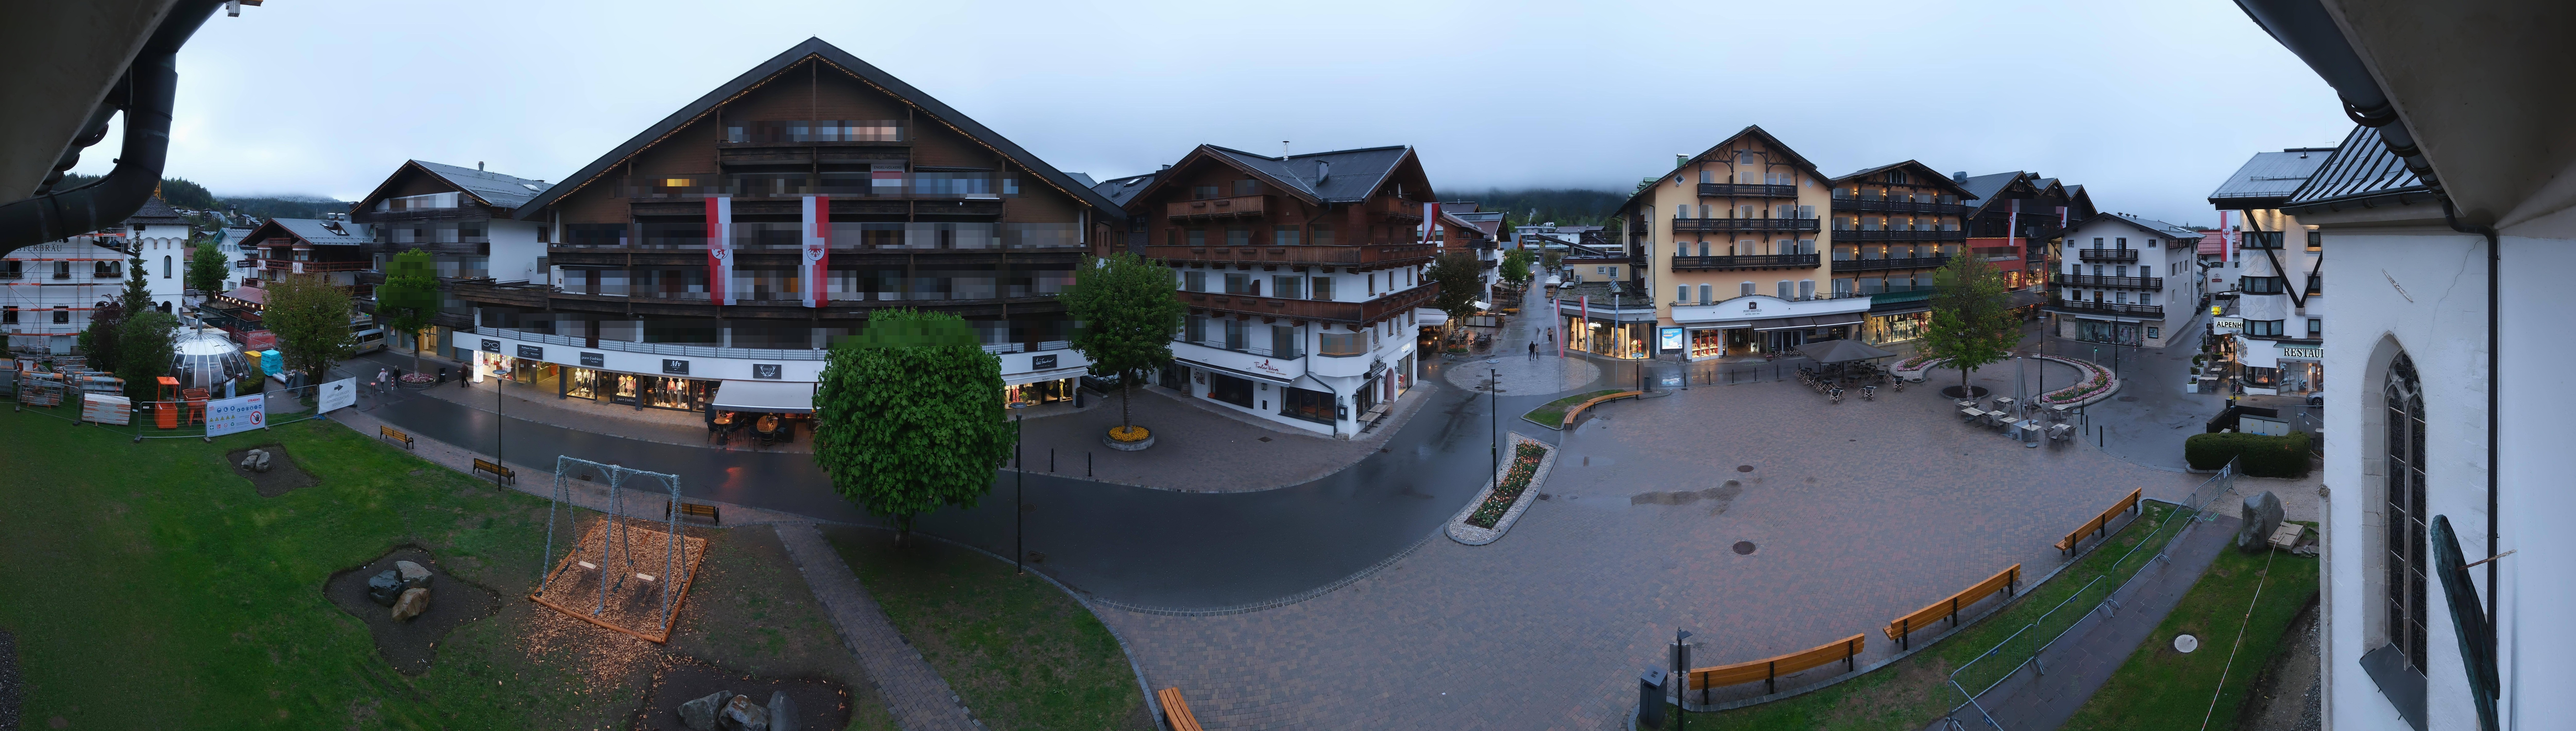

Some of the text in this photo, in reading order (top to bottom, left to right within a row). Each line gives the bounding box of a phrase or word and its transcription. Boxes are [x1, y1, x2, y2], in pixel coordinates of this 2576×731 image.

[670, 361, 681, 370] My
[1371, 364, 1385, 377] RESTAURANT
[327, 395, 349, 403] KONGRESSZENTRUM
